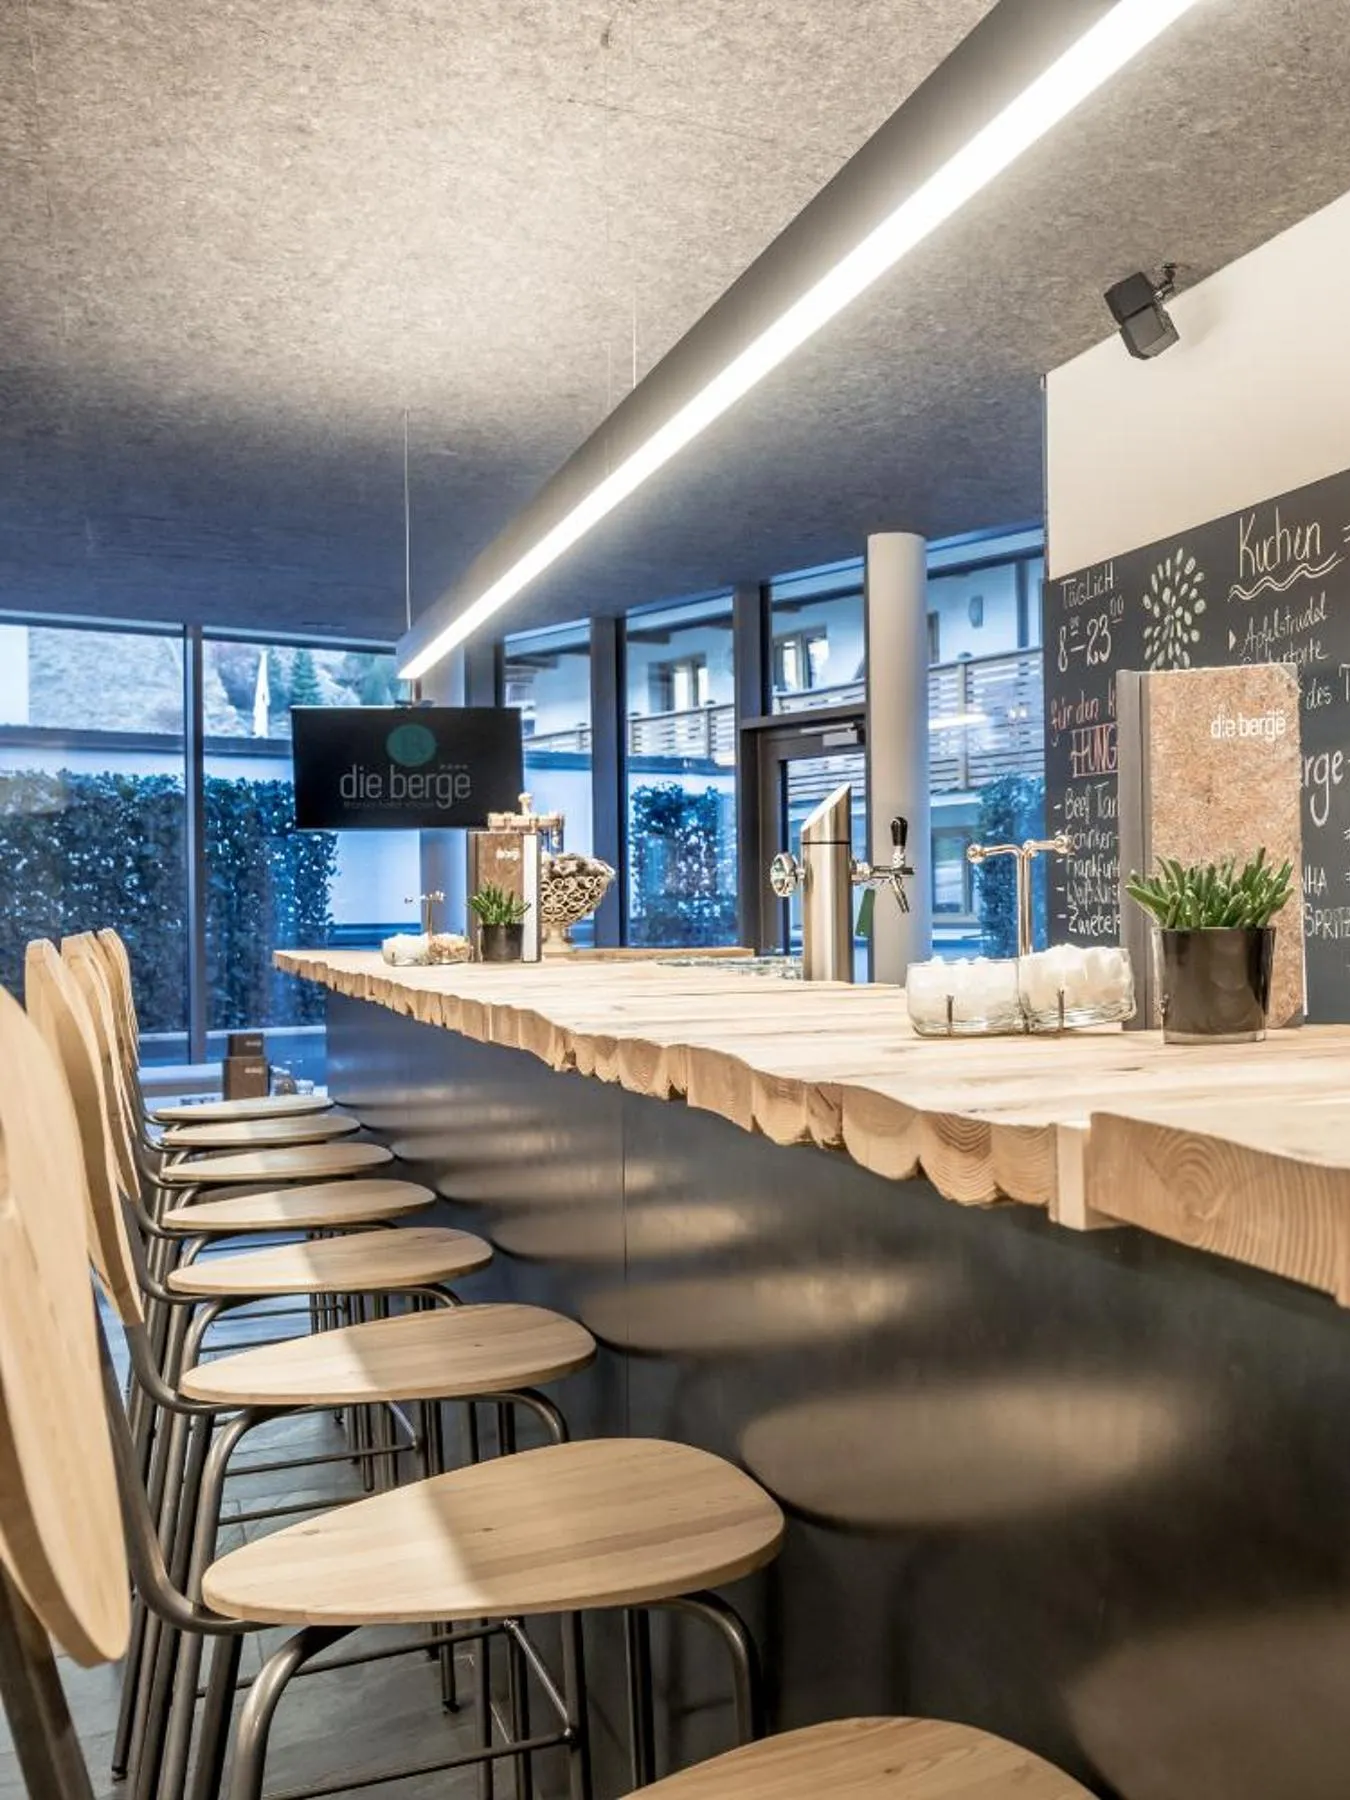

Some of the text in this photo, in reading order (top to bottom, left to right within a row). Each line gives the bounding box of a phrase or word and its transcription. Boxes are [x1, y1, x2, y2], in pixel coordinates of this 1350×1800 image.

[1239, 506, 1322, 578] Kuchen
[1305, 678, 1333, 710] des
[1210, 712, 1236, 738] die
[340, 763, 472, 810] die berge
[1064, 784, 1091, 824] Beef
[1068, 904, 1120, 937] Zwiebel
